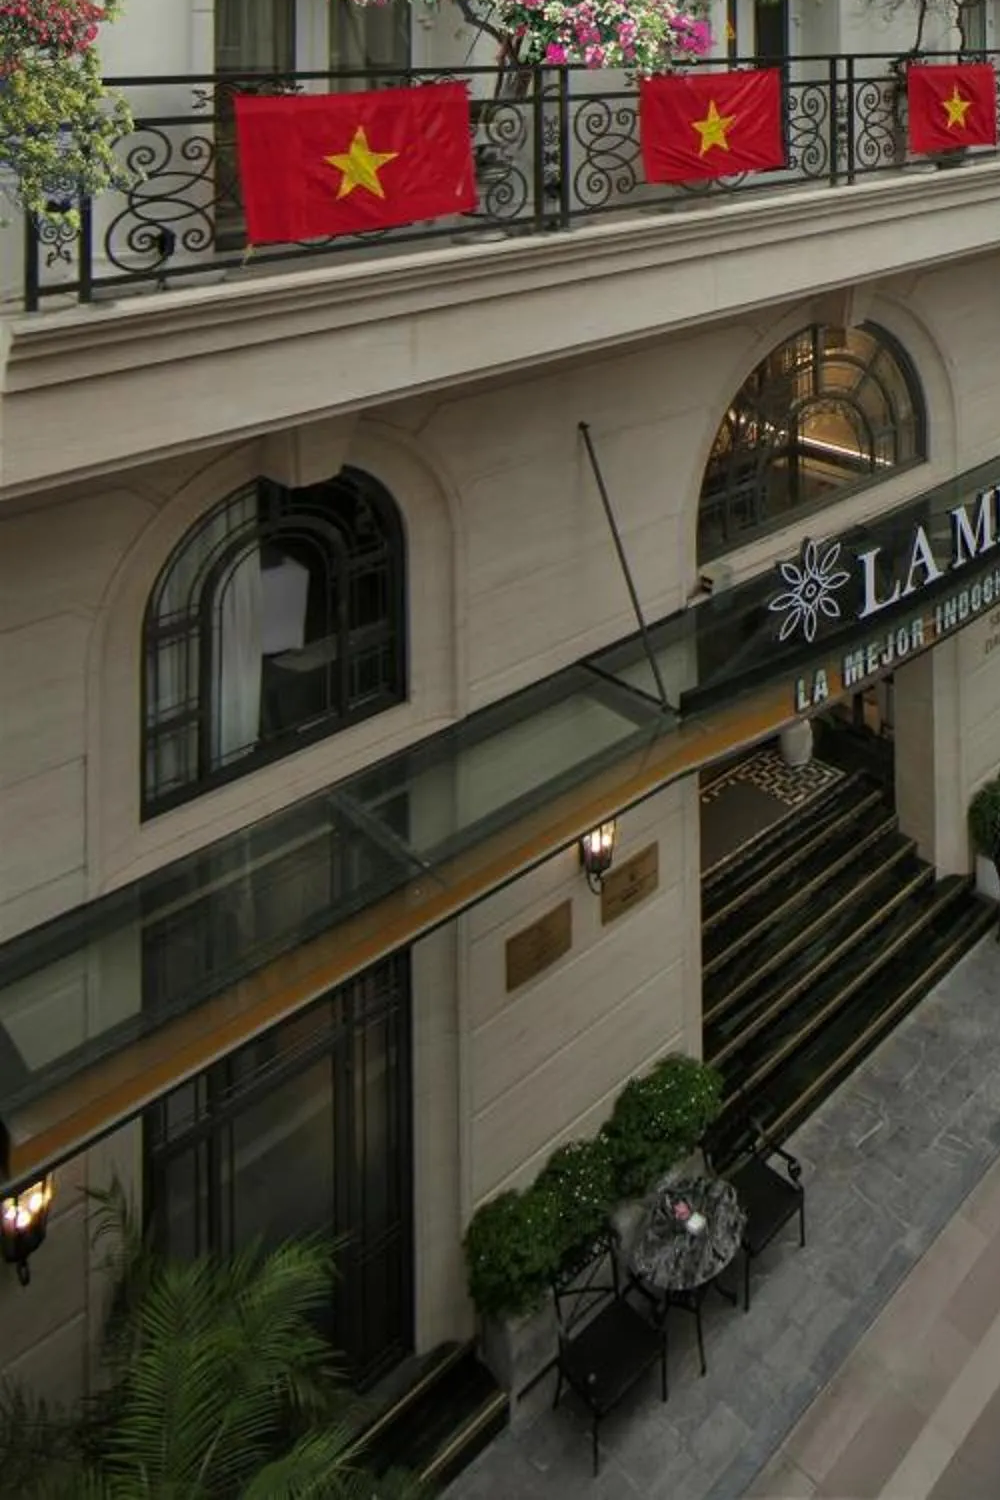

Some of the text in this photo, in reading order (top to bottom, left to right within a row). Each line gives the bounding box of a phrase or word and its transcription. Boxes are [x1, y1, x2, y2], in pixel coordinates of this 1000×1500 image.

[857, 524, 944, 619] LA
[796, 669, 829, 711] LA
[843, 618, 924, 686] MEJOR
